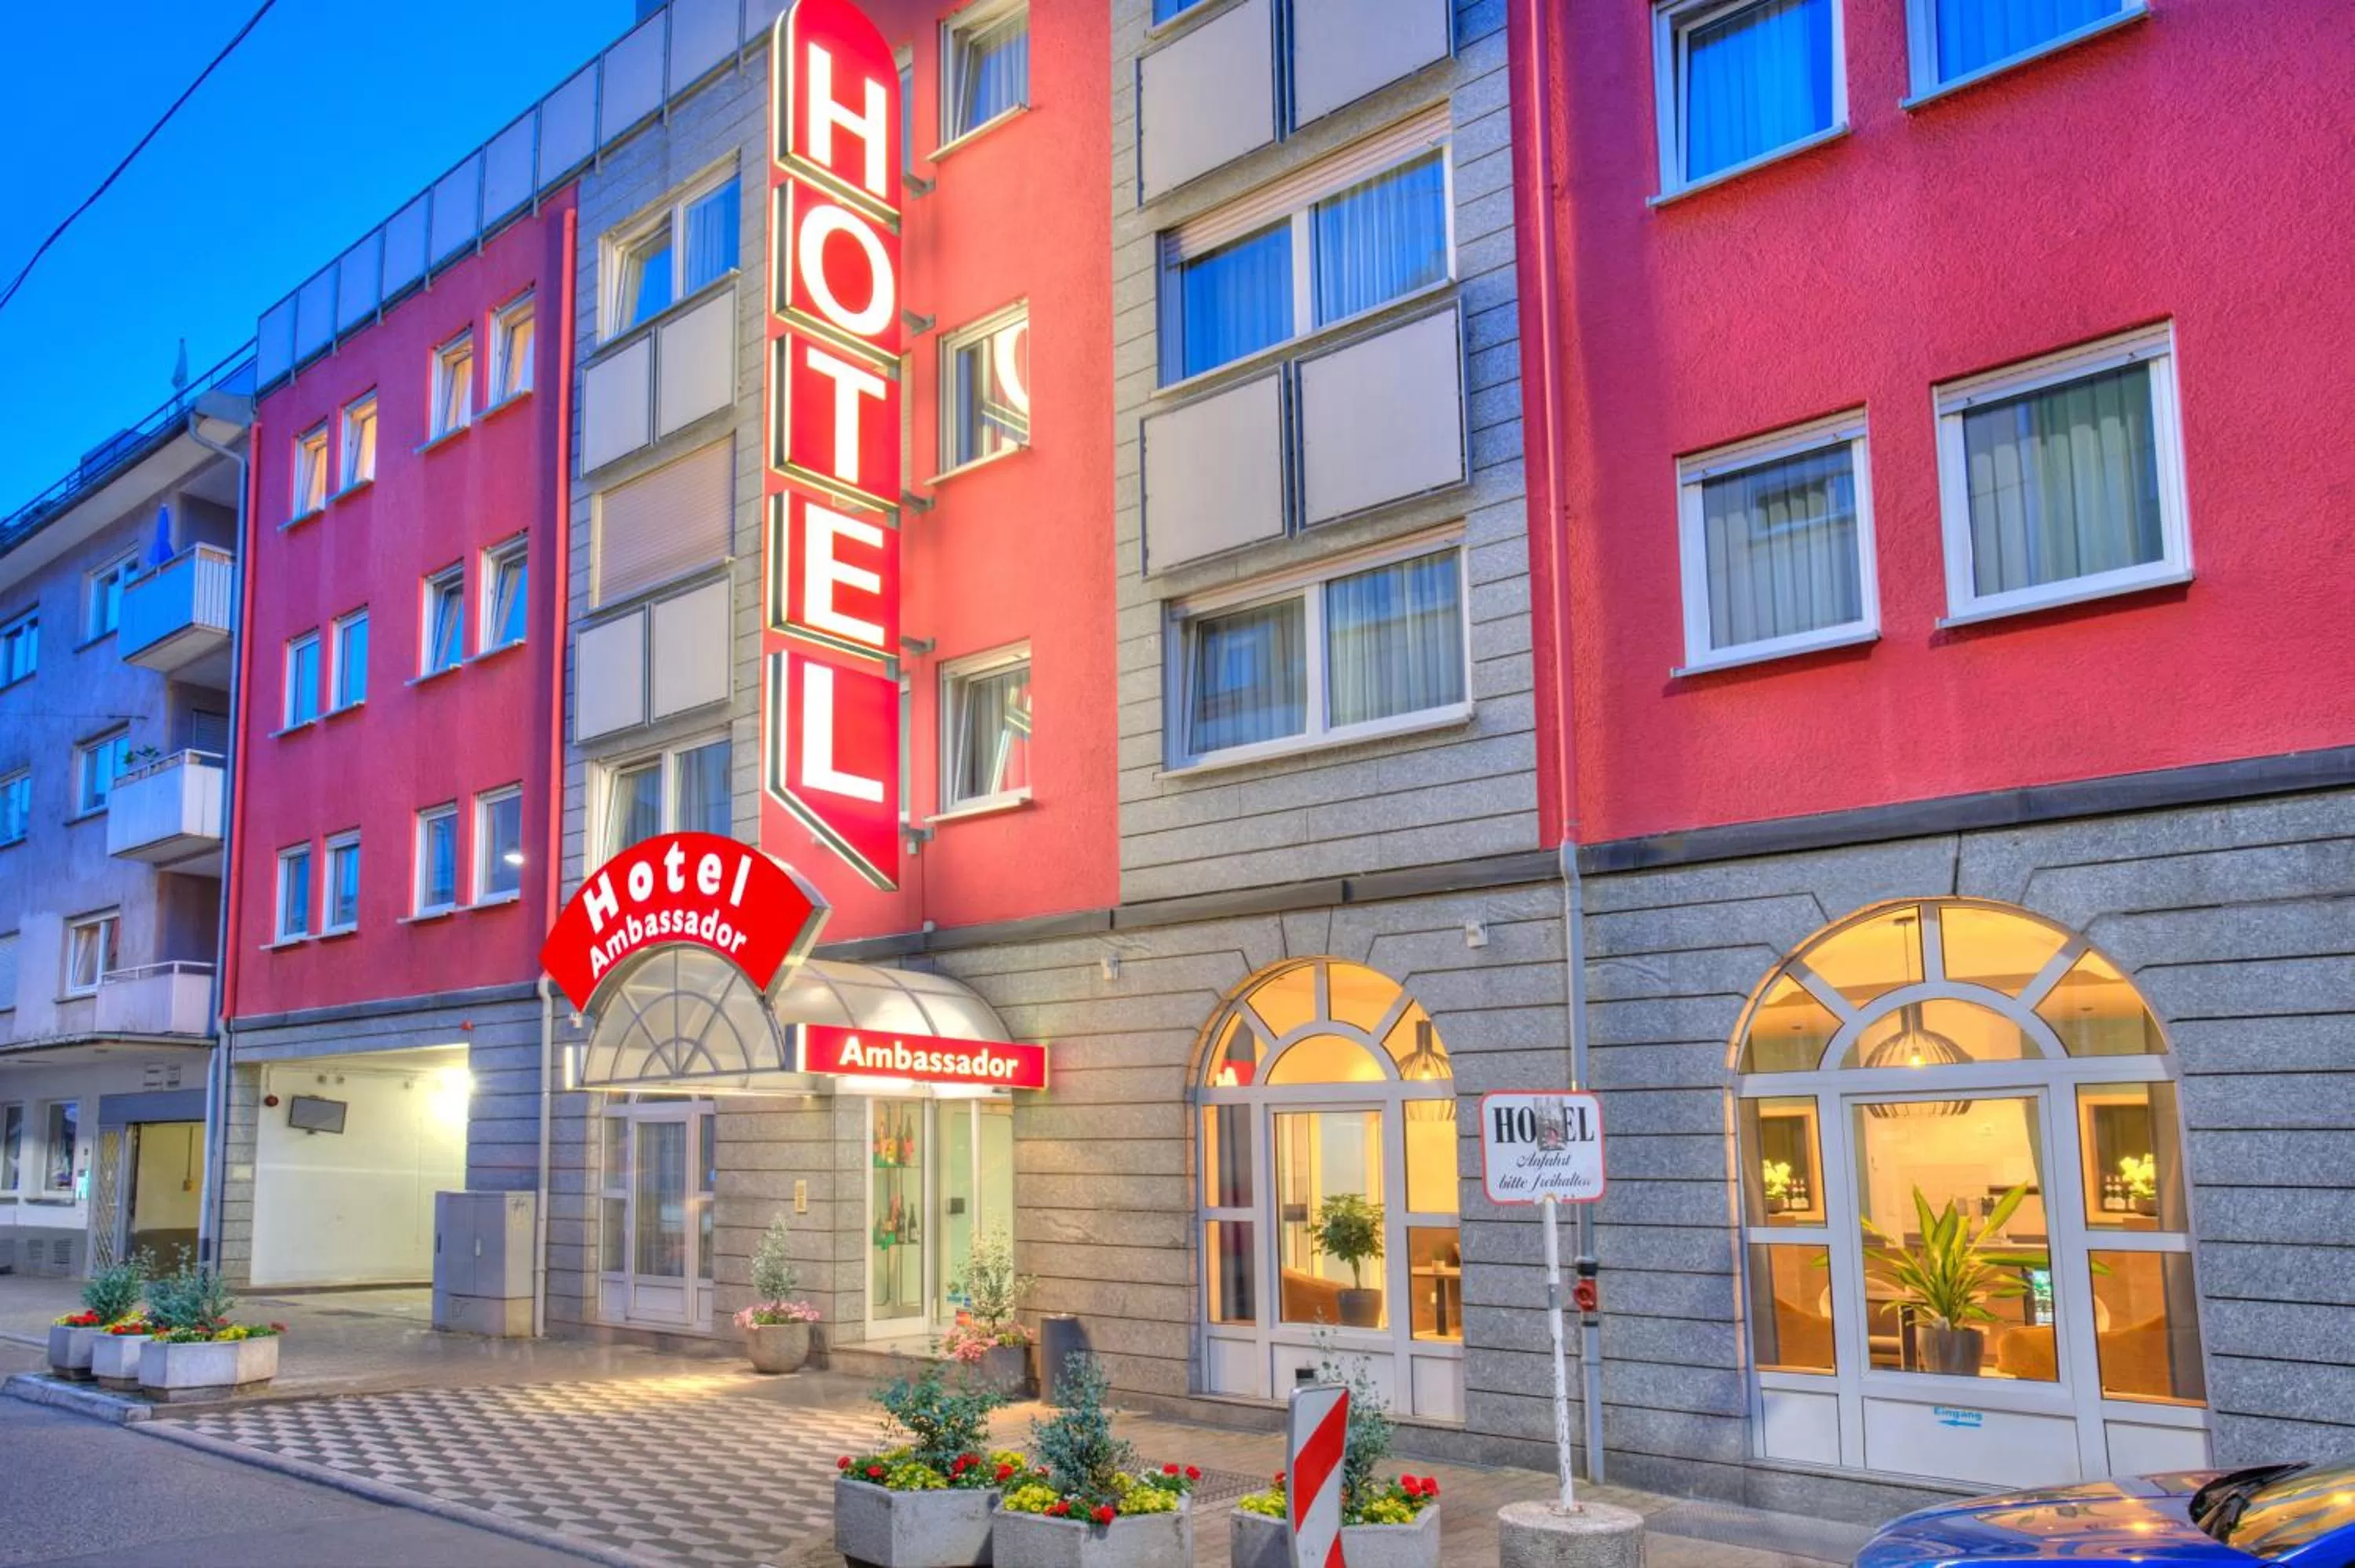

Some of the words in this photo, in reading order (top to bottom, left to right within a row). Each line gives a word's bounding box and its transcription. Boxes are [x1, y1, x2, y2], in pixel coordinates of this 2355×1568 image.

[798, 42, 895, 803] HOTEL
[582, 841, 752, 935] Hotel
[590, 908, 747, 979] Ambassador
[838, 1035, 1019, 1078] Ambassador
[1494, 1106, 1594, 1143] HOEL
[1499, 1174, 1528, 1189] bitte
